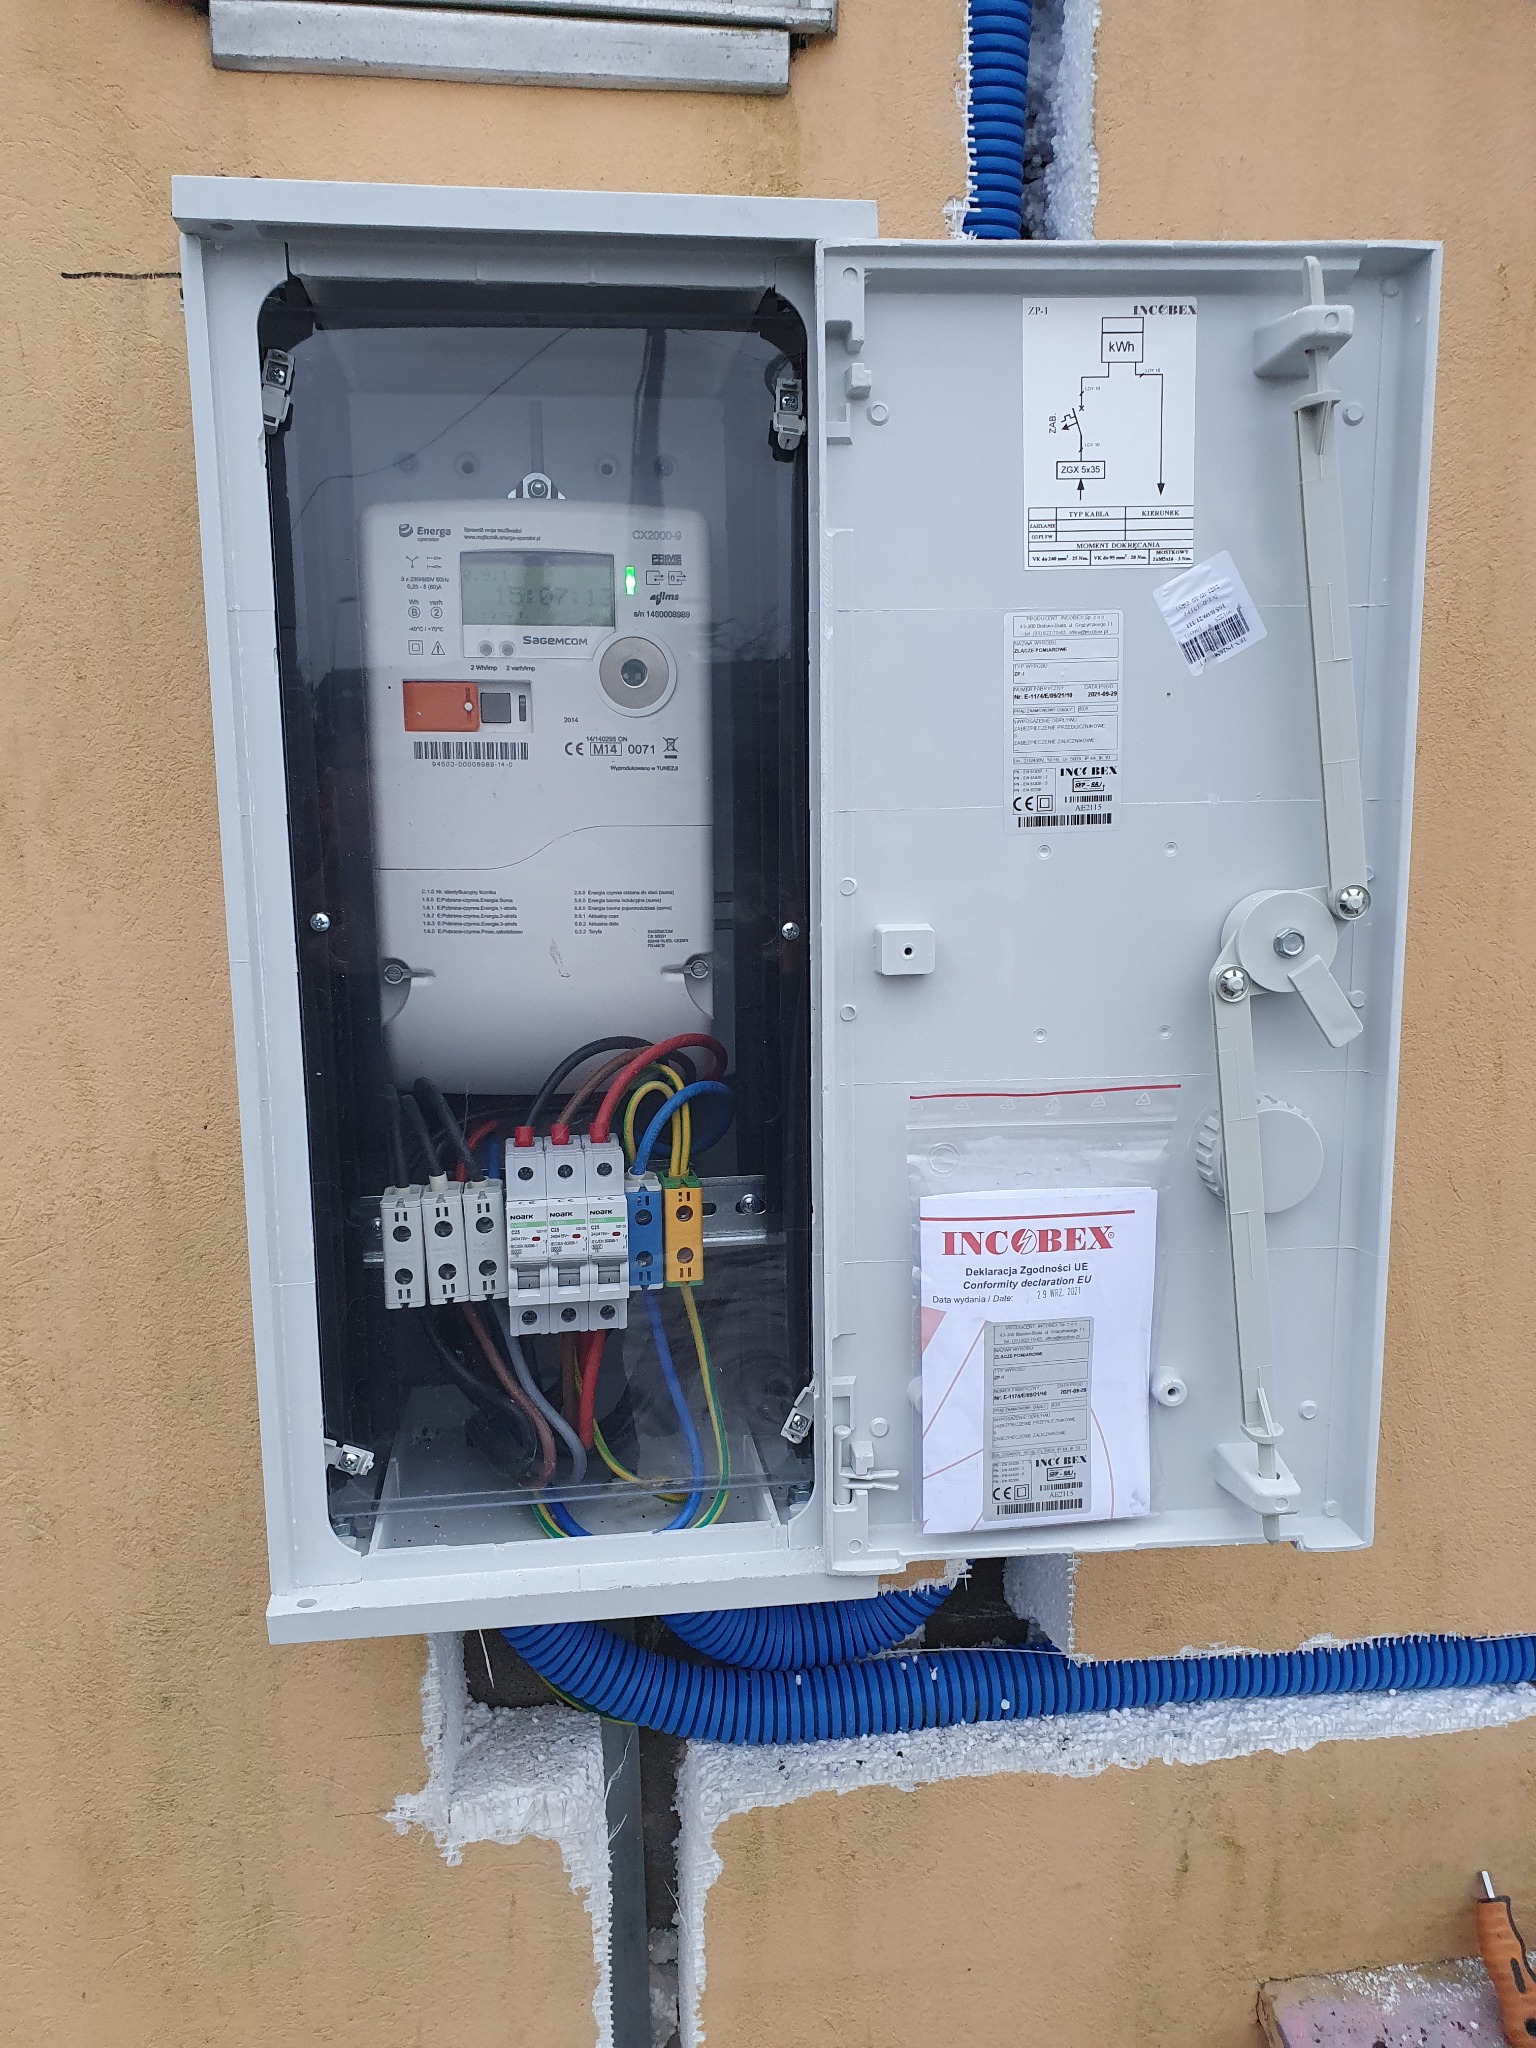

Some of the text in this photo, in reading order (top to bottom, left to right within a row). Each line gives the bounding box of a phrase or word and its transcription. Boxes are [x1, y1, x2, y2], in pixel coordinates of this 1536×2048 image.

[1028, 307, 1048, 315] ZP-1
[1109, 341, 1135, 352] kWh
[417, 527, 451, 537] Energa
[632, 530, 681, 540] CX2000-9
[634, 610, 644, 618] s/n
[593, 745, 618, 754] M14
[628, 745, 655, 755] 0071
[965, 1263, 1088, 1276] Deklaracja Zgodności UE
[963, 1275, 1092, 1290] Conformity declaration EU
[933, 1295, 951, 1304] Data
[954, 1295, 986, 1304] wydania
[993, 1294, 1013, 1303] Date:
[1049, 1490, 1074, 1498] AE2115
